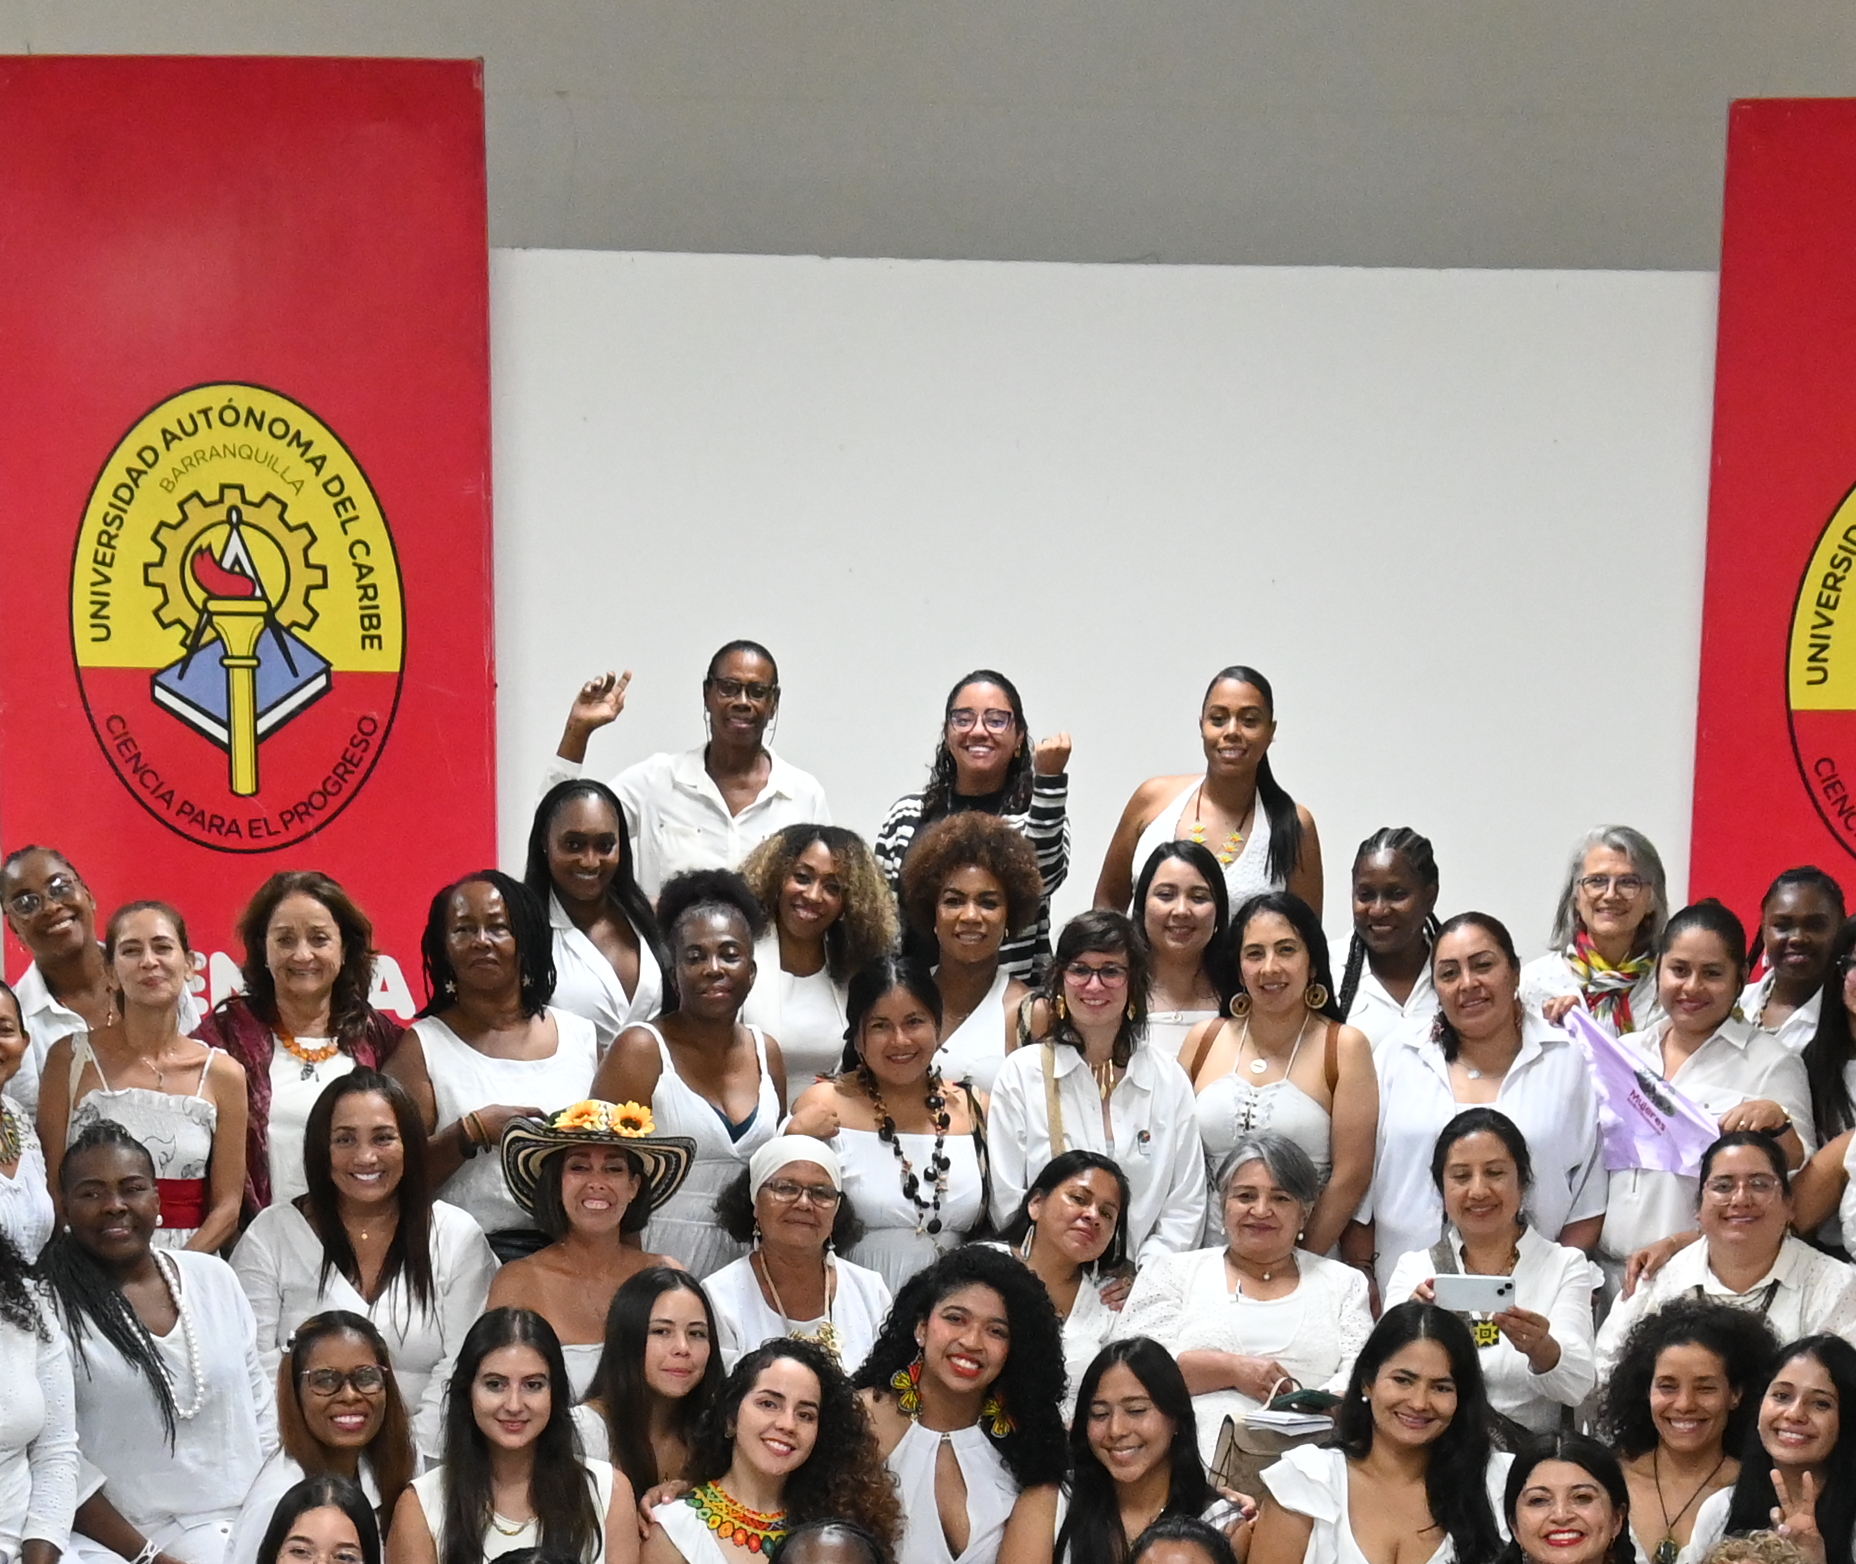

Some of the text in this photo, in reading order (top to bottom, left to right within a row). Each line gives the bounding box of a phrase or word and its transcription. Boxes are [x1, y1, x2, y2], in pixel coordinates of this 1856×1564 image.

[89, 397, 383, 652] UNIVERSIDAD AUTÓNOMA DEL CARIBE
[159, 443, 306, 497] BARRANQUILLA
[105, 713, 379, 839] CIENCIA PARA EL PROGRESO
